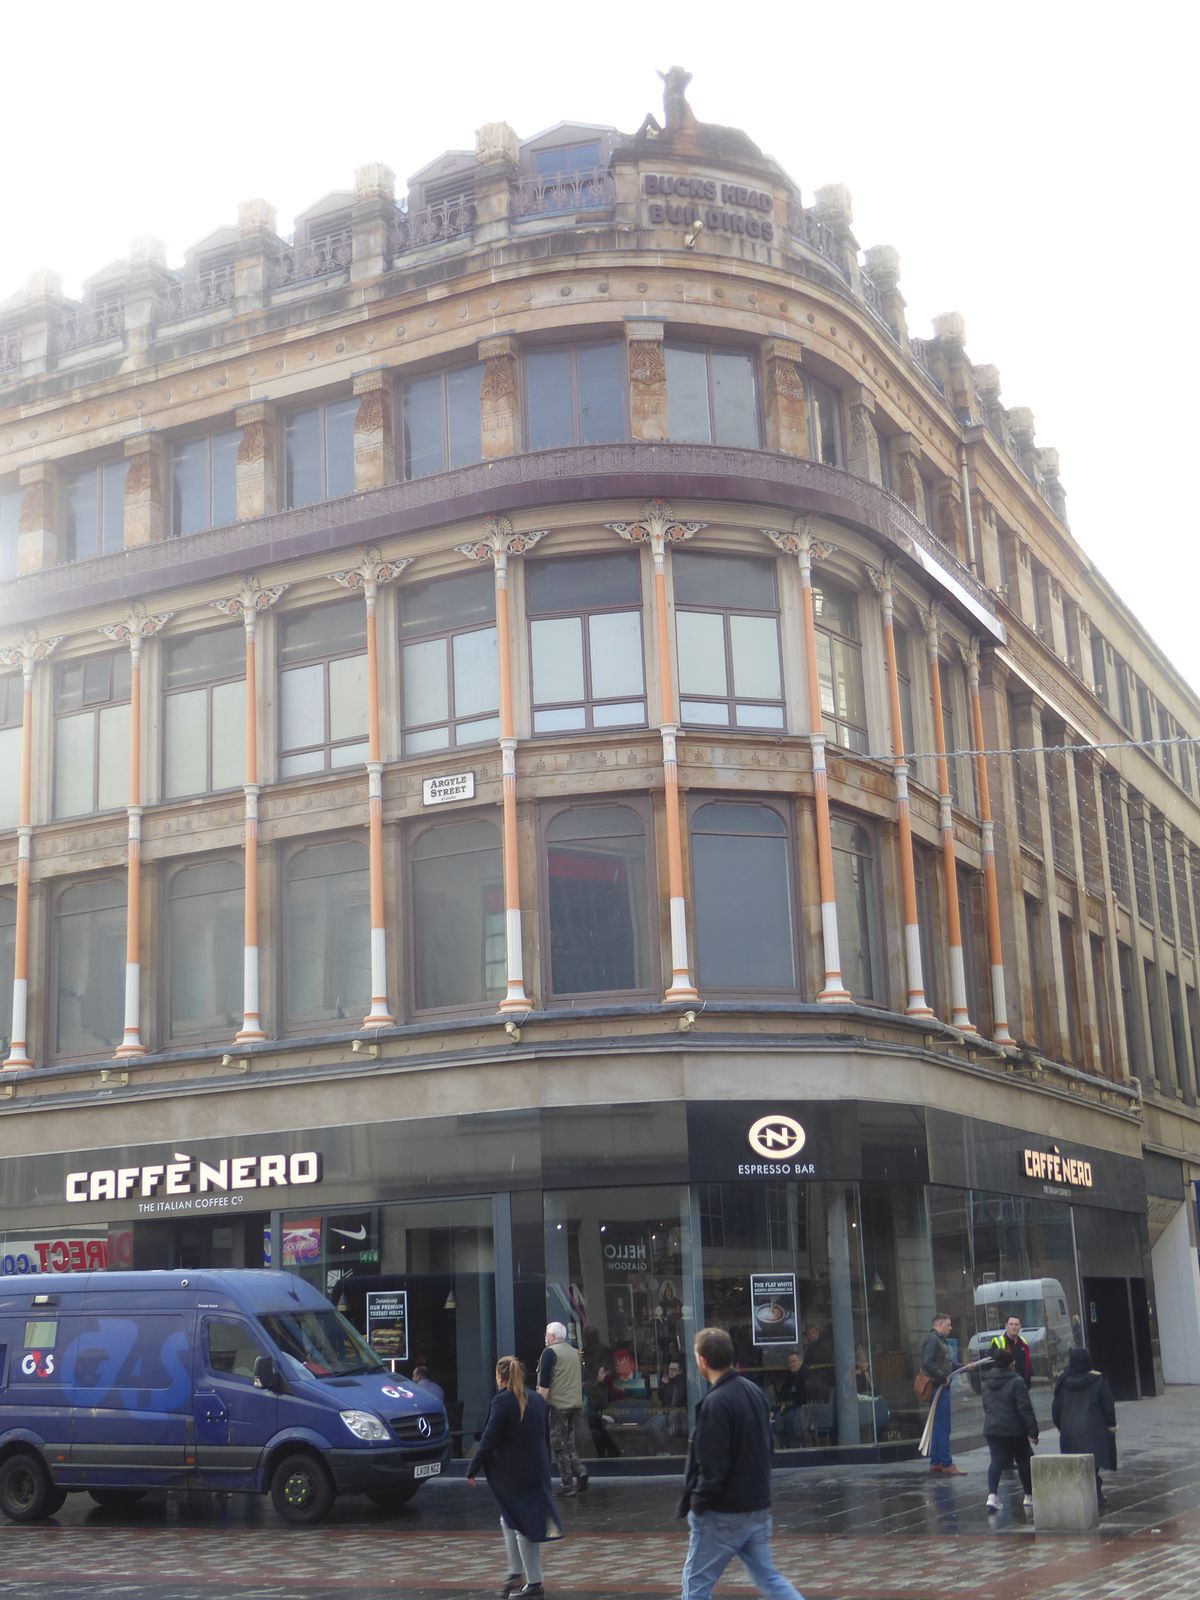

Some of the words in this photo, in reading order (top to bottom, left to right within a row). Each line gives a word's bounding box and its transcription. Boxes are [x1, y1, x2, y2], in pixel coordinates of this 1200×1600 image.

[644, 174, 717, 201] BUCKS
[721, 183, 774, 213] HEAD
[199, 1151, 319, 1192] NERO
[738, 1164, 791, 1175] ESPRESSO
[794, 1163, 815, 1174] BAR
[1062, 1157, 1093, 1187] NERO
[138, 1203, 155, 1213] THE
[156, 1200, 192, 1211] ITALIAN
[195, 1197, 229, 1208] COFFEE
